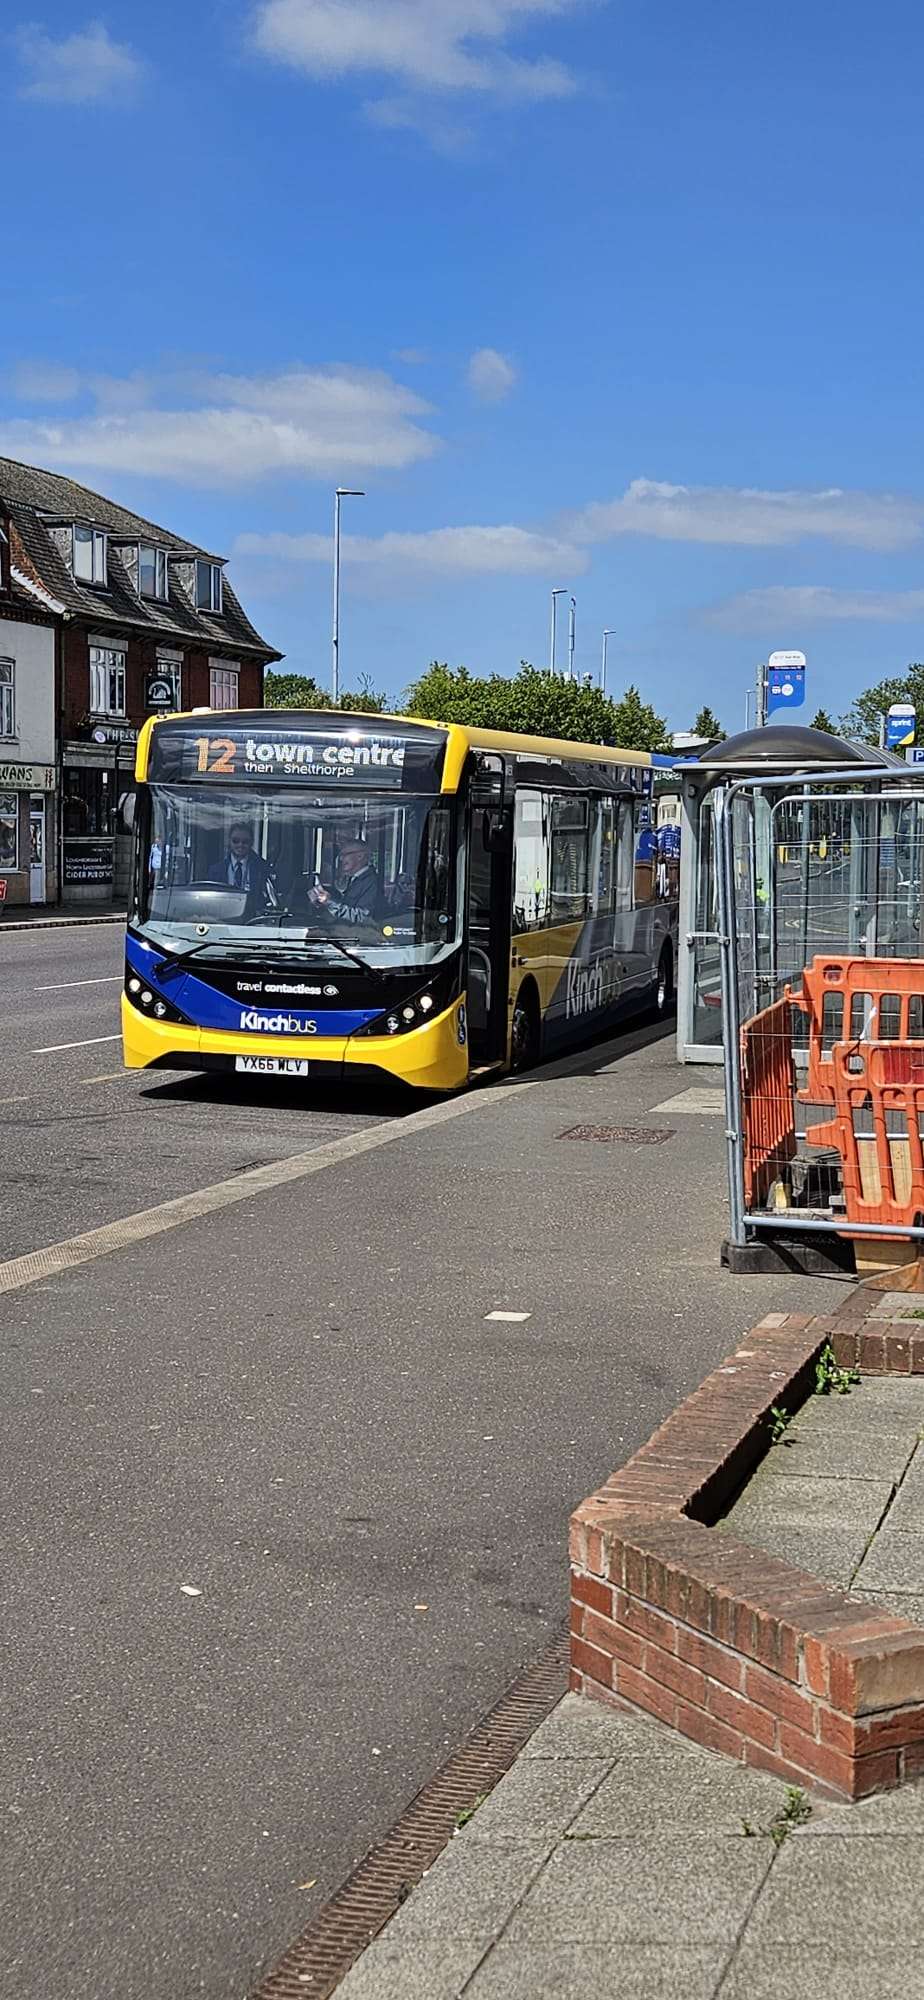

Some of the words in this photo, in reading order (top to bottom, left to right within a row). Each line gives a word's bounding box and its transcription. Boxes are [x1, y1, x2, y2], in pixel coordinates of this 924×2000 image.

[194, 737, 237, 773] 12
[245, 739, 314, 763] town
[322, 743, 405, 766] centre
[916, 751, 924, 761] P
[0, 766, 33, 782] VANS
[244, 761, 274, 773] then
[283, 762, 354, 778] Shelthorpe
[237, 981, 262, 992] travel
[264, 983, 322, 995] contactless
[240, 1011, 317, 1033] Kinchbus
[242, 1057, 274, 1071] YX66
[278, 1059, 303, 1072] WLV
